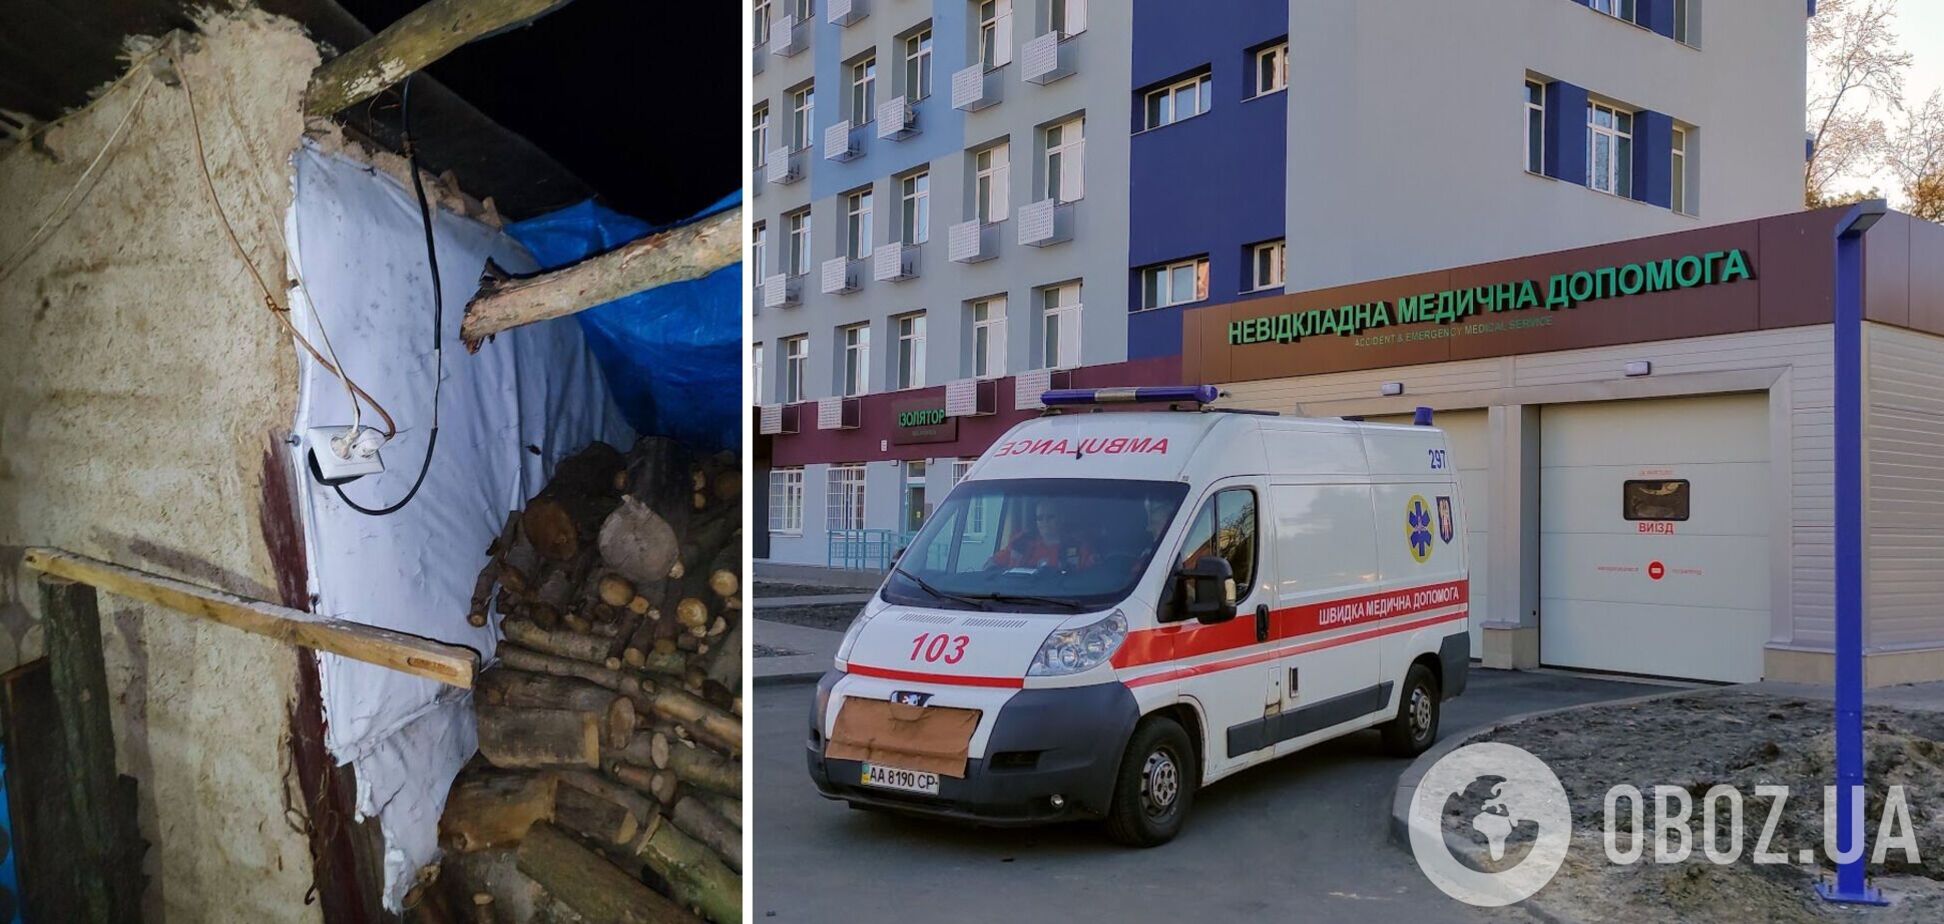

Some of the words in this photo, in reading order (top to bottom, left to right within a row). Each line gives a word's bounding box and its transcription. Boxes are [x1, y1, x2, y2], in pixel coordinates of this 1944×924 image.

[1228, 301, 1390, 345] НЕВІДКЛАДНА
[1397, 279, 1539, 325] МЕДИЧНА
[1545, 248, 1750, 309] ДОПОМОГА
[1354, 334, 1396, 347] ACCIDENT
[1406, 326, 1463, 342] EMERGENCY
[1464, 320, 1506, 337] MEDICAL
[898, 408, 945, 426] ІЗОЛЯТОР
[1428, 449, 1446, 469] 297
[1318, 604, 1365, 625] ШВИДКА
[1366, 594, 1412, 617] МЕДИЧНА
[1413, 586, 1459, 610] ДОПОМОГА
[910, 632, 970, 665] 103
[888, 770, 915, 788] 8190
